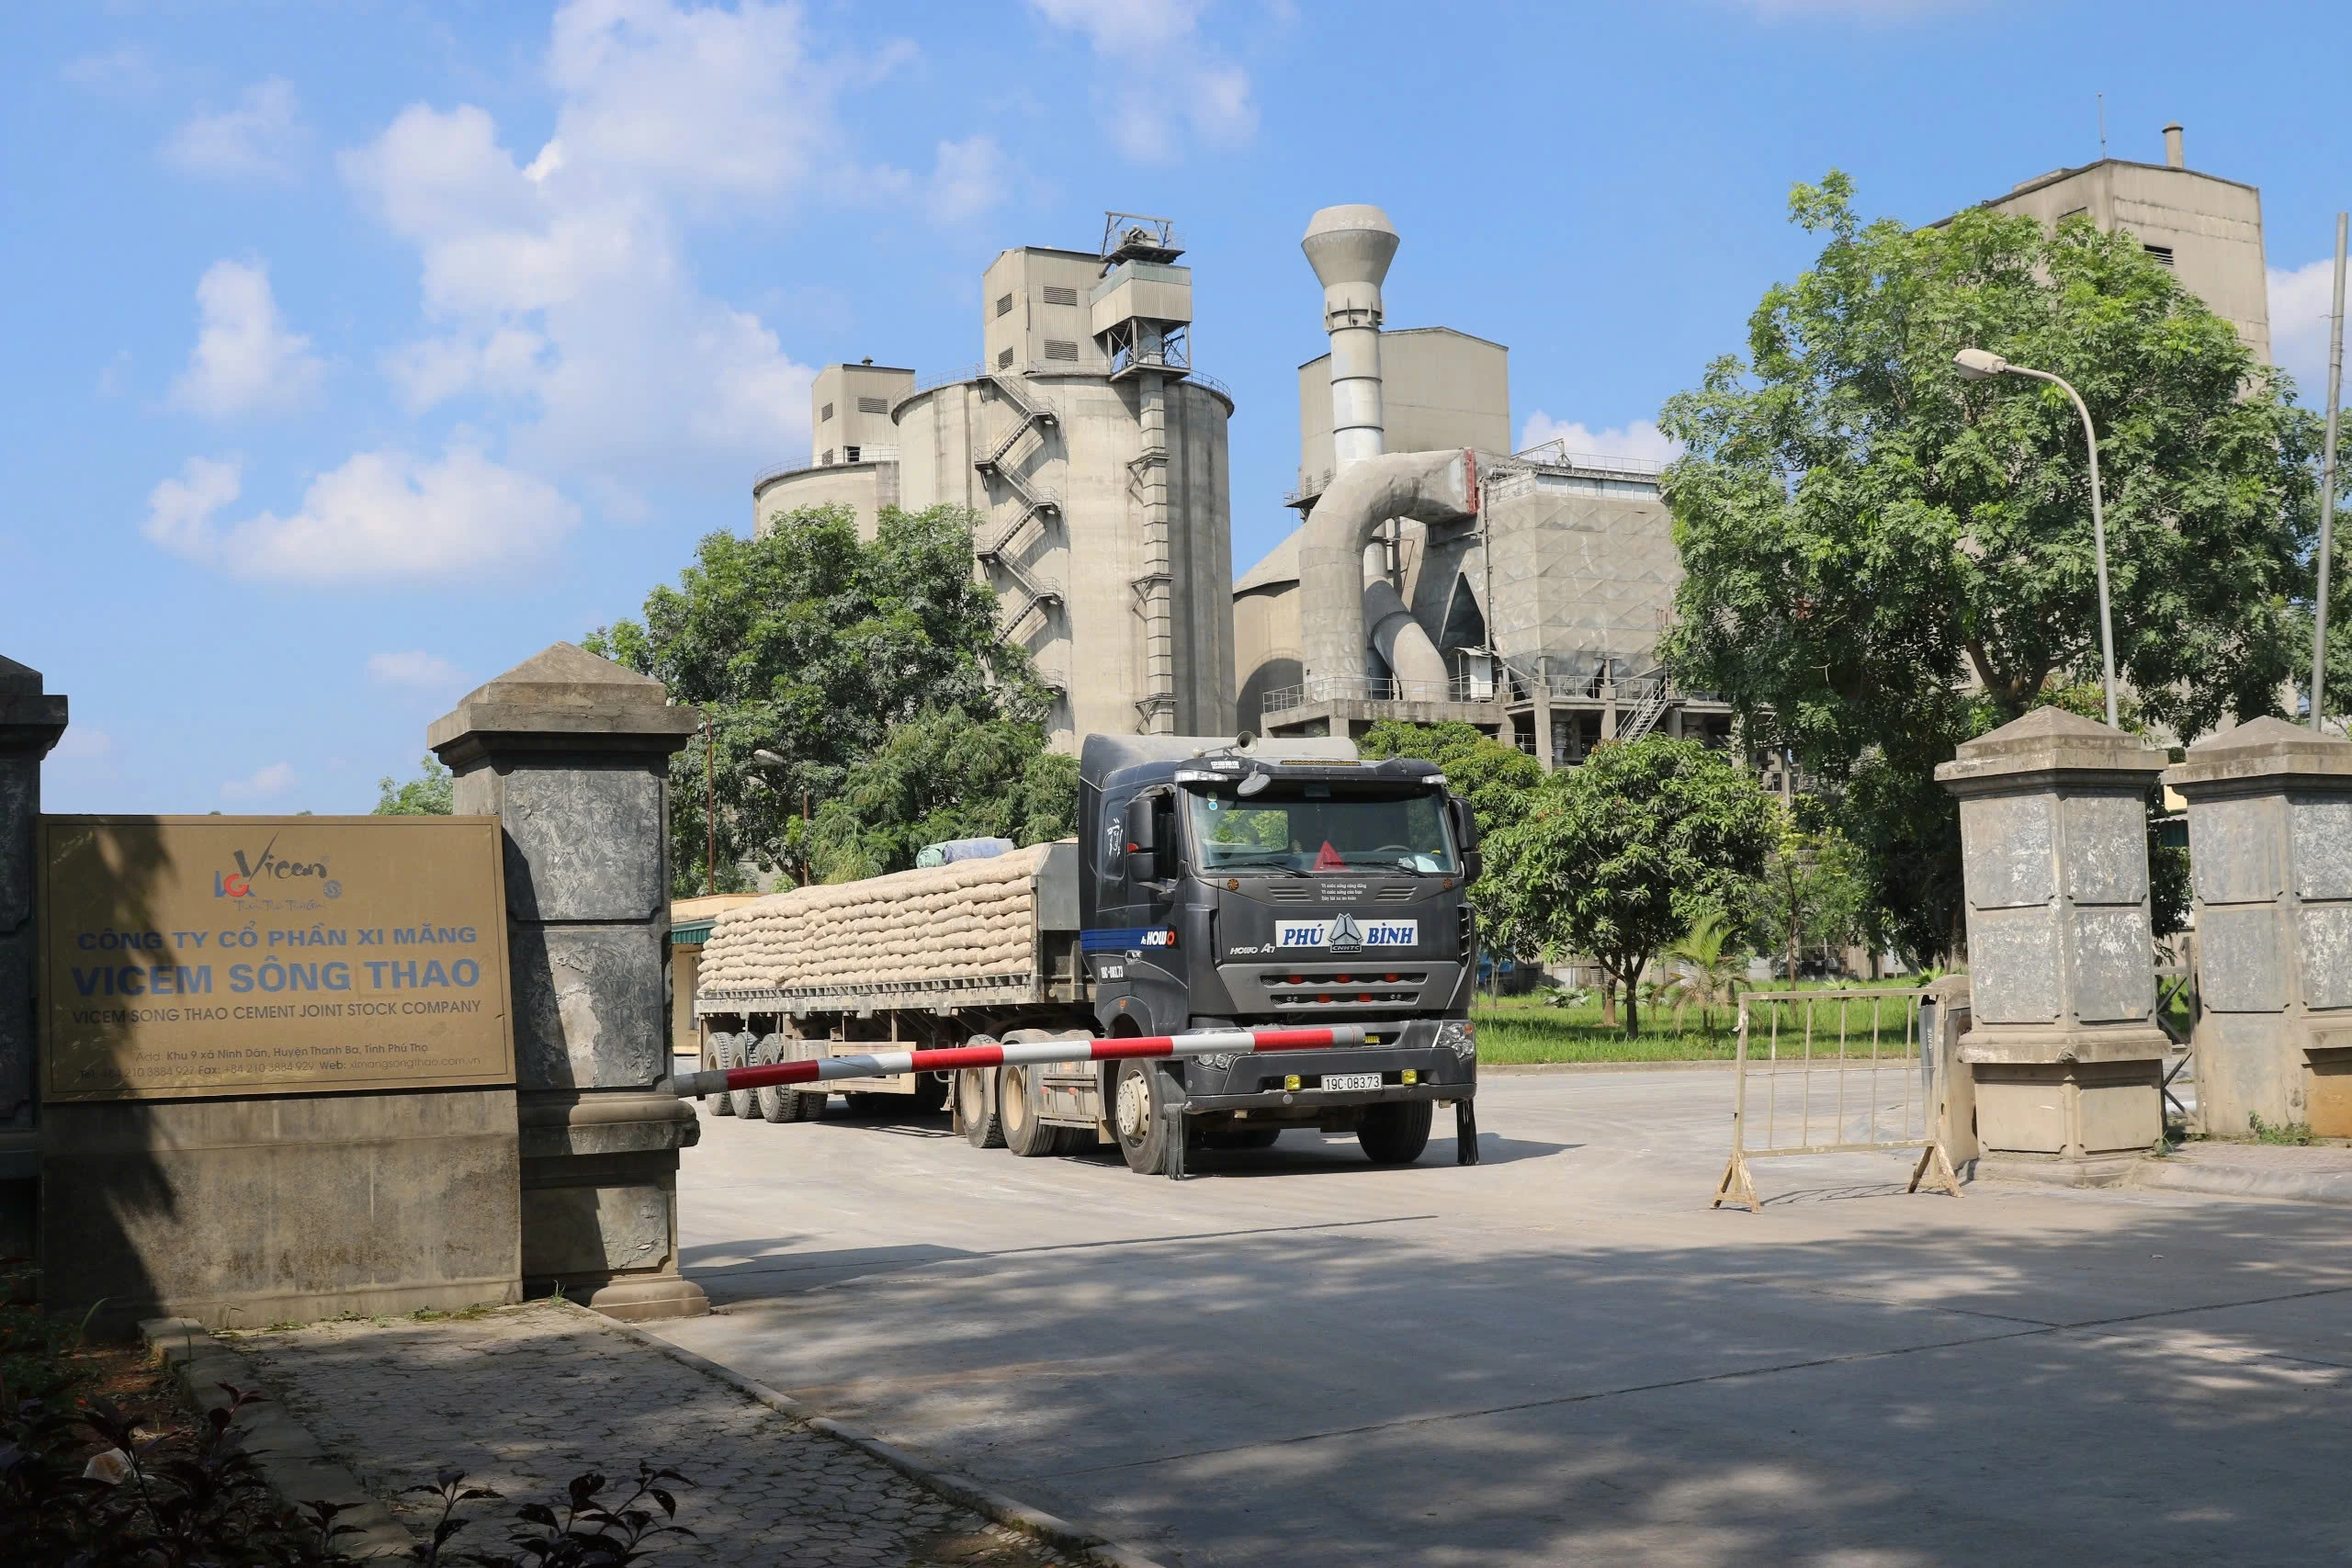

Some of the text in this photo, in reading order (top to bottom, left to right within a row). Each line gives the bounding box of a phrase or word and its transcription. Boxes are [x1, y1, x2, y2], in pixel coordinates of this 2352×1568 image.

[77, 920, 478, 951] CÔNG TY CỔ PHẦN XI MĂNG
[1146, 930, 1176, 946] HOWO
[1283, 922, 1414, 945] PHÚ BÌNH
[1229, 942, 1276, 955] HOWO A7
[71, 954, 481, 997] VICEM SÔNG THAO
[74, 999, 482, 1024] VICEM SONG THAO CEMENT JOINT STOCK COMPANY
[166, 1050, 188, 1061] Khu
[190, 1050, 198, 1060] 9
[217, 1049, 243, 1059] Ninh
[273, 1046, 309, 1058] Huyện
[311, 1045, 342, 1055] Thanh
[345, 1044, 362, 1055] Ba,
[388, 1042, 407, 1053] Phú
[124, 1066, 144, 1078] 210
[147, 1066, 173, 1077] 3884
[175, 1065, 195, 1076] 927
[198, 1065, 221, 1075] Fax:
[223, 1064, 243, 1074] +84
[246, 1063, 266, 1073] 210
[319, 1061, 346, 1071] Web:
[1326, 1076, 1380, 1090] 19C-083.73
